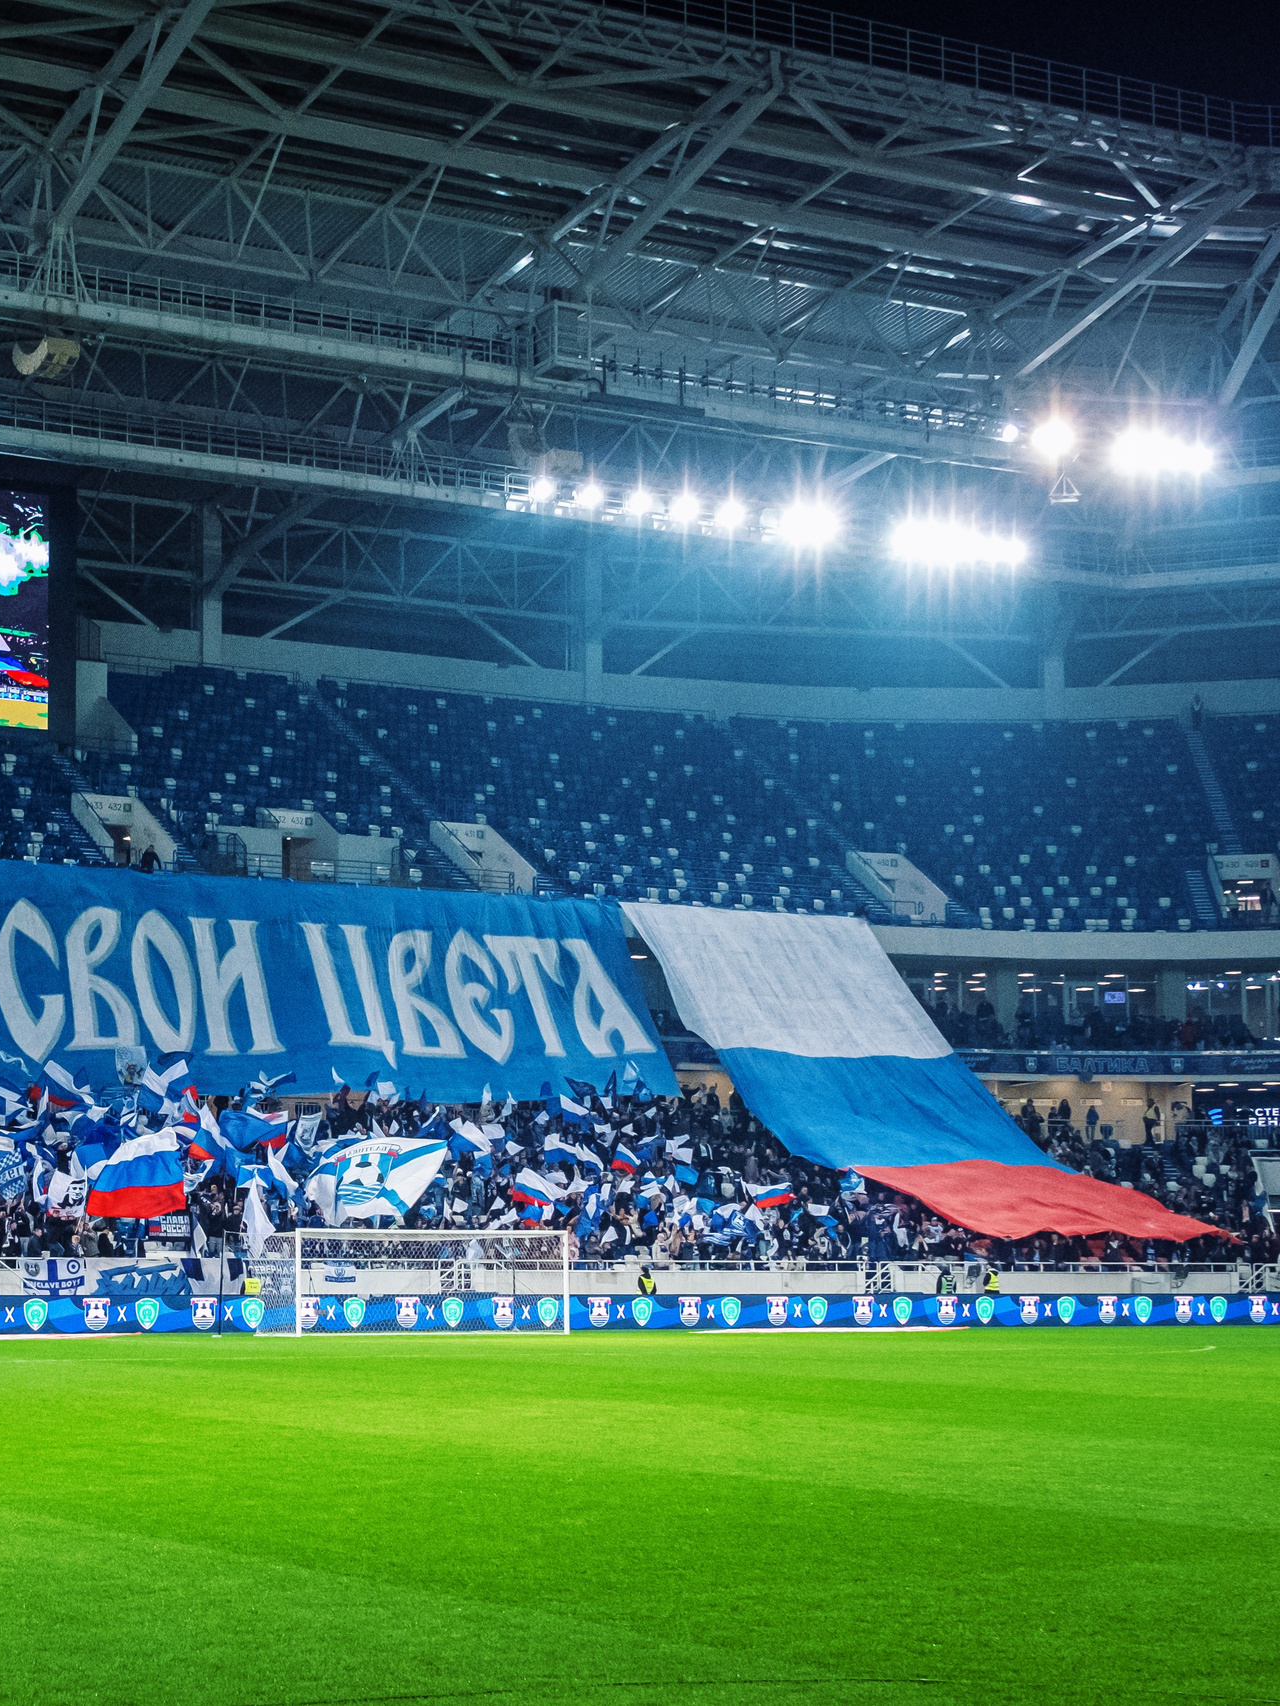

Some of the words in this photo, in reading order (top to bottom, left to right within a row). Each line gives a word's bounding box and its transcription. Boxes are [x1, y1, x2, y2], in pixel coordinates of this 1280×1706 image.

[297, 920, 659, 1069] ЦВЕТА
[1056, 1057, 1149, 1073] БАЛТИКА
[160, 1215, 190, 1224] СЛАВА
[160, 1224, 191, 1233] РОССИИ
